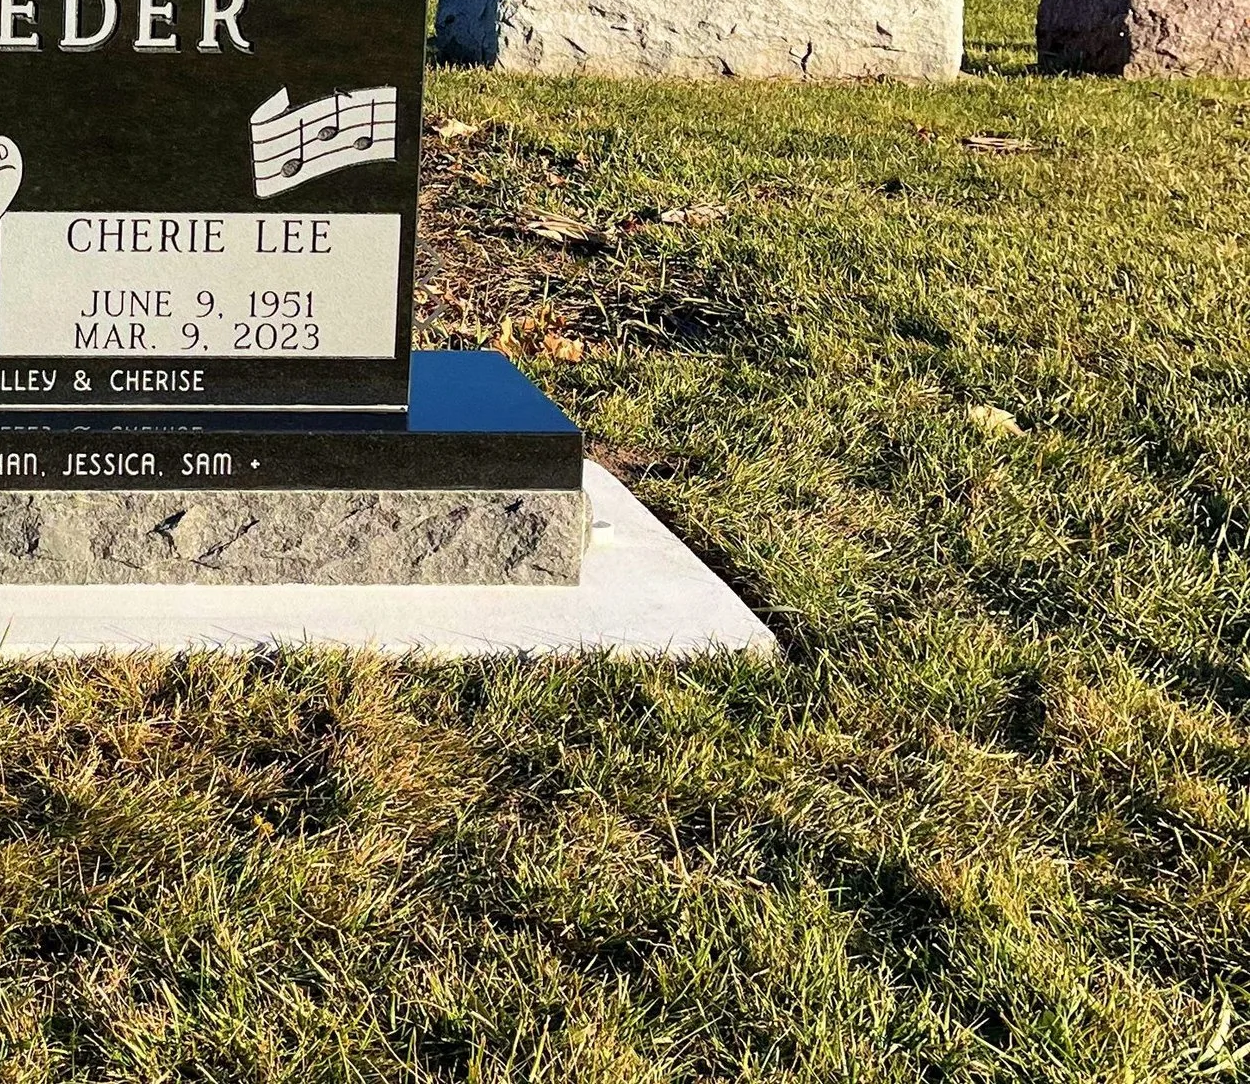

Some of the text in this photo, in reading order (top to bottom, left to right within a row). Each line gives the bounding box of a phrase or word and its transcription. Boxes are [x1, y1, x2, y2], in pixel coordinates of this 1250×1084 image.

[67, 218, 333, 254] CHERIE LEE
[81, 290, 314, 320] JUNE 9, 1951
[74, 323, 320, 352] MAR. 9, 2023
[73, 369, 92, 392] &
[110, 369, 205, 392] CHERISE
[62, 452, 164, 477] JESSICA,
[181, 452, 233, 476] SAM
